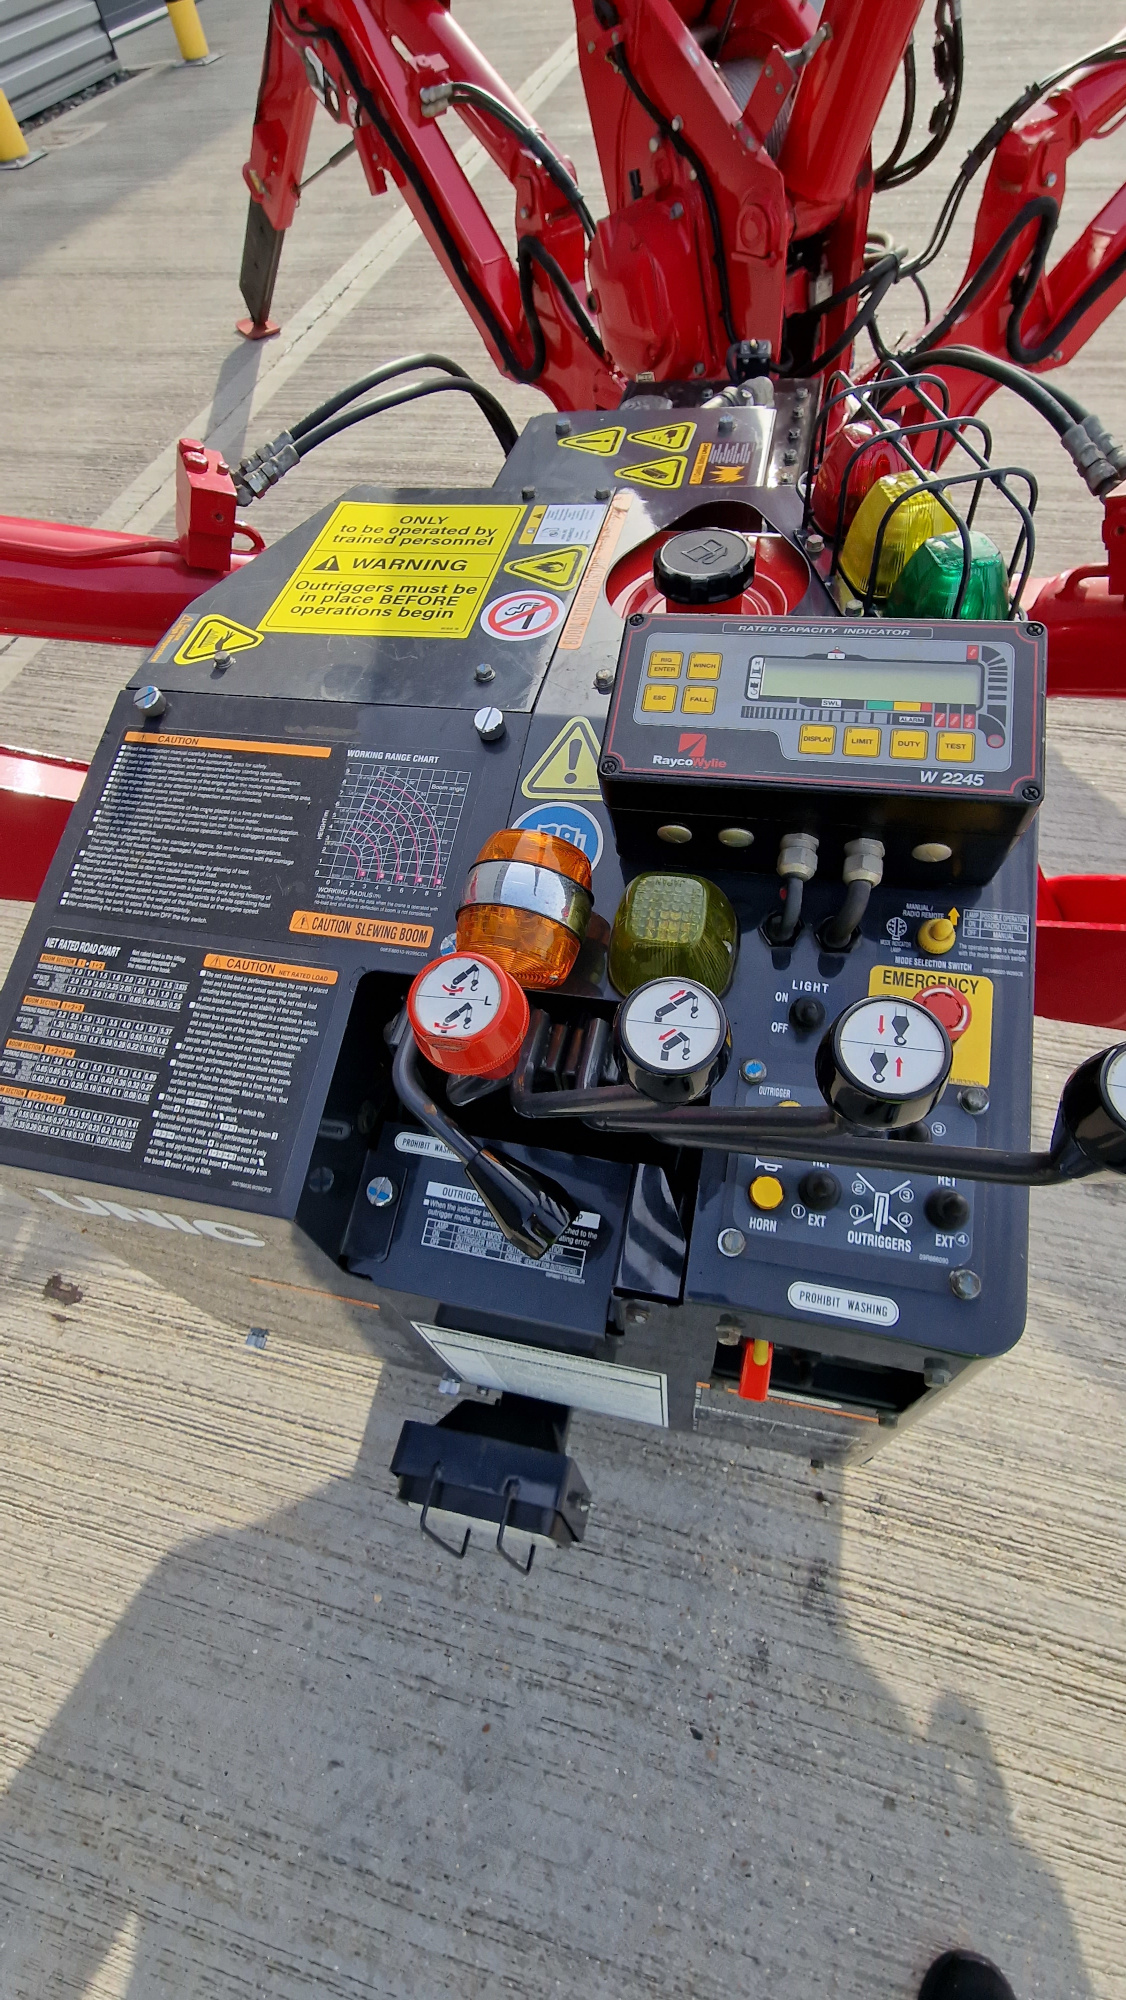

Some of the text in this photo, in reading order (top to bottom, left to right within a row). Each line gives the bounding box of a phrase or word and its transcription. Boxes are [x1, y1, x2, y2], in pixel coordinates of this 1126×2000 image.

[399, 515, 449, 525] ONLY
[340, 524, 499, 538] to be operated by
[332, 535, 495, 548] trained personnel
[351, 557, 469, 572] WARNING
[295, 578, 479, 593] Outriggers must be
[299, 590, 460, 606] in place BEFORE
[289, 605, 454, 621] operations begin
[738, 625, 911, 636] RATED CAPACITY INDICATOR
[693, 662, 716, 670] WINCH
[157, 736, 200, 746] CAUTION
[803, 735, 967, 750] DISPLAY LIMIT DUTY TEST
[347, 749, 440, 765] WORKING RANGE CHART
[652, 754, 727, 770] RaycoWylie
[920, 770, 985, 786] W 2245
[431, 783, 466, 794] Boom angle
[318, 886, 349, 896] WORKING
[902, 909, 945, 920] RADIO REMOTE
[906, 903, 930, 912] MANUAL
[311, 918, 429, 944] CAUTION SLEWING BOOM
[984, 922, 999, 930] RADIO
[1000, 923, 1024, 932] CONTROL
[992, 931, 1014, 940] MANUAL
[44, 936, 122, 957] NET RATED ROAD CHART
[226, 957, 329, 982] CAUTION NET RATED LOAD
[894, 955, 973, 971] MODE SELECTION SWITCH
[792, 979, 830, 994] LIGHT
[882, 969, 980, 996] EMERGENCY
[774, 991, 789, 1003] ON
[771, 1021, 789, 1034] OFF
[758, 1085, 792, 1098] OUTRIGGER
[401, 1137, 431, 1151] PROHIBIT
[937, 1174, 957, 1188] RET
[441, 1187, 486, 1204] OUTRIGGE
[429, 1199, 482, 1217] When the indicator
[36, 1187, 265, 1247] UNIC
[427, 1208, 453, 1223] outrigger
[453, 1213, 472, 1224] mode.
[472, 1216, 482, 1226] Be
[749, 1216, 778, 1233] HORN
[807, 1212, 827, 1228] EXT
[581, 1230, 588, 1238] to
[587, 1231, 598, 1241] the
[847, 1230, 913, 1254] OUTRIGGERS
[935, 1232, 955, 1248] EXT
[574, 1239, 592, 1248] error.
[798, 1289, 890, 1318] PROHIBIT WASHING
